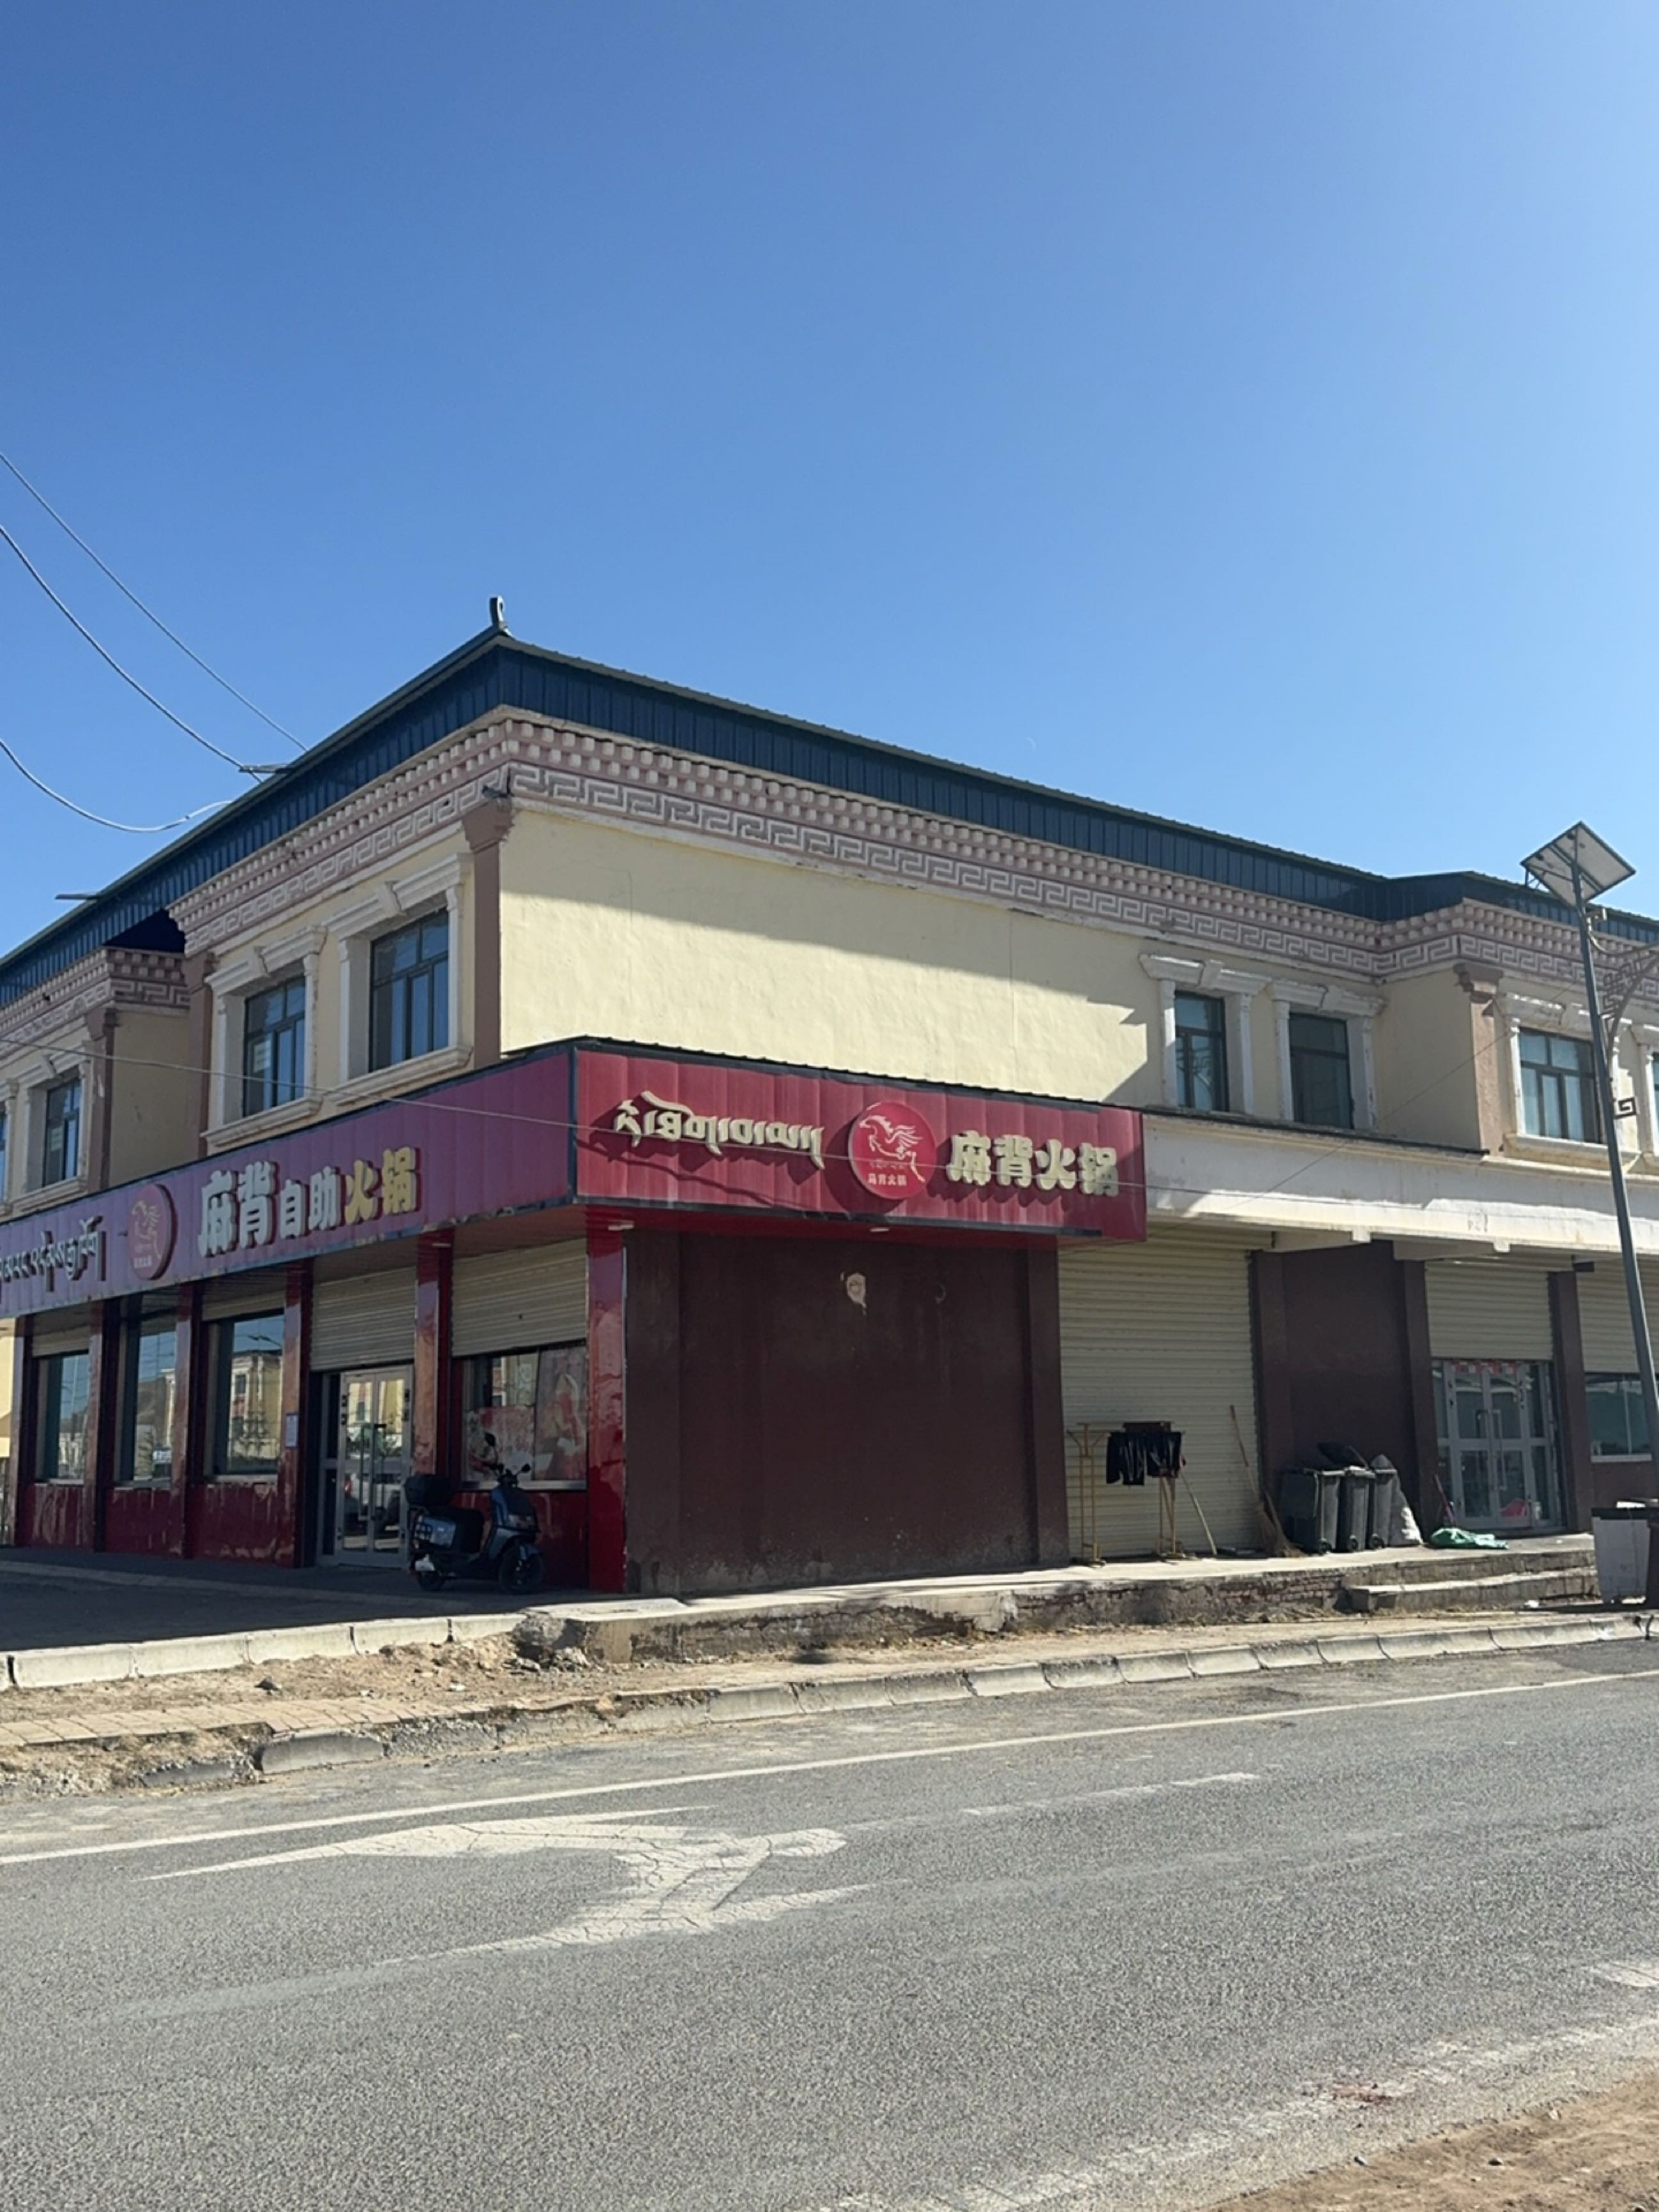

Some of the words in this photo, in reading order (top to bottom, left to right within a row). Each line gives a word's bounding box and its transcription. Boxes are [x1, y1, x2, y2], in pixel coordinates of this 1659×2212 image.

[198, 1147, 417, 1258] 麻背自助火锅
[945, 1130, 1119, 1197] 麻背火锅
